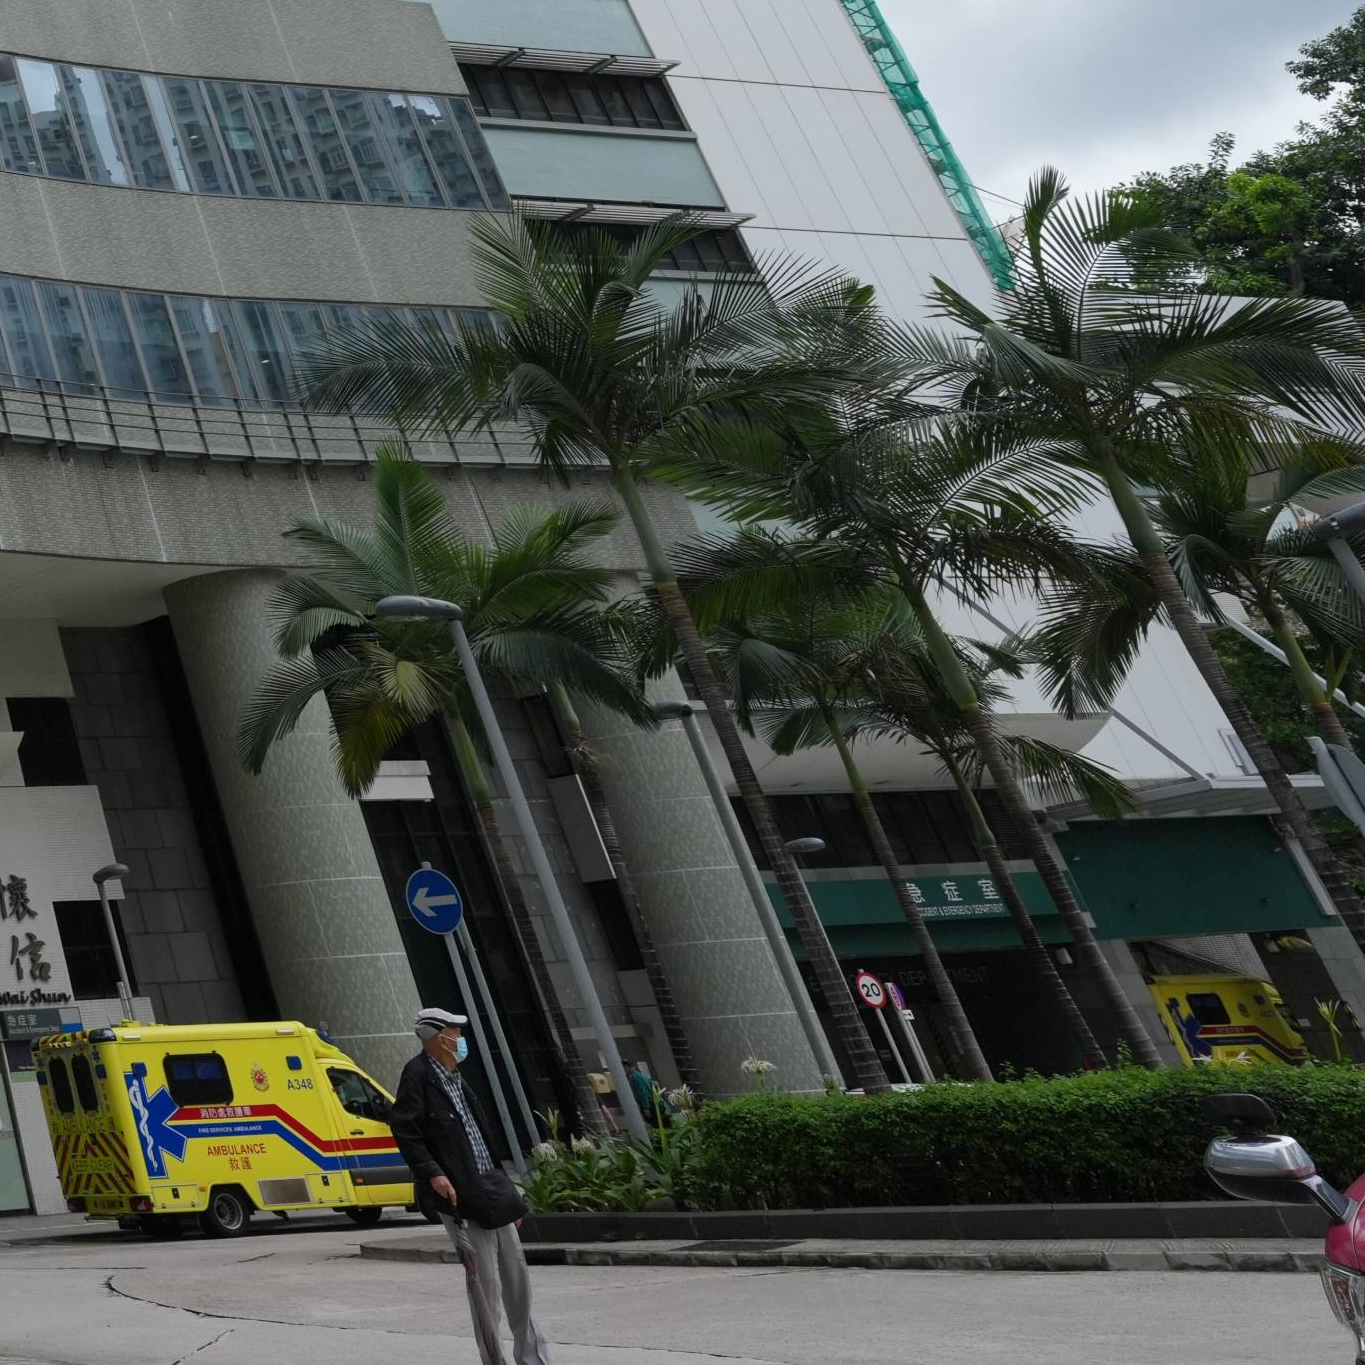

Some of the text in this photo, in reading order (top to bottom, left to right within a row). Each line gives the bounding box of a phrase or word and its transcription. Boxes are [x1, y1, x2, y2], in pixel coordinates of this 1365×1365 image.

[30, 988, 71, 1005] Shun
[862, 983, 880, 997] 20
[287, 1078, 314, 1091] A348
[207, 1143, 267, 1156] AMBULANCE
[229, 1157, 252, 1171] 救護
